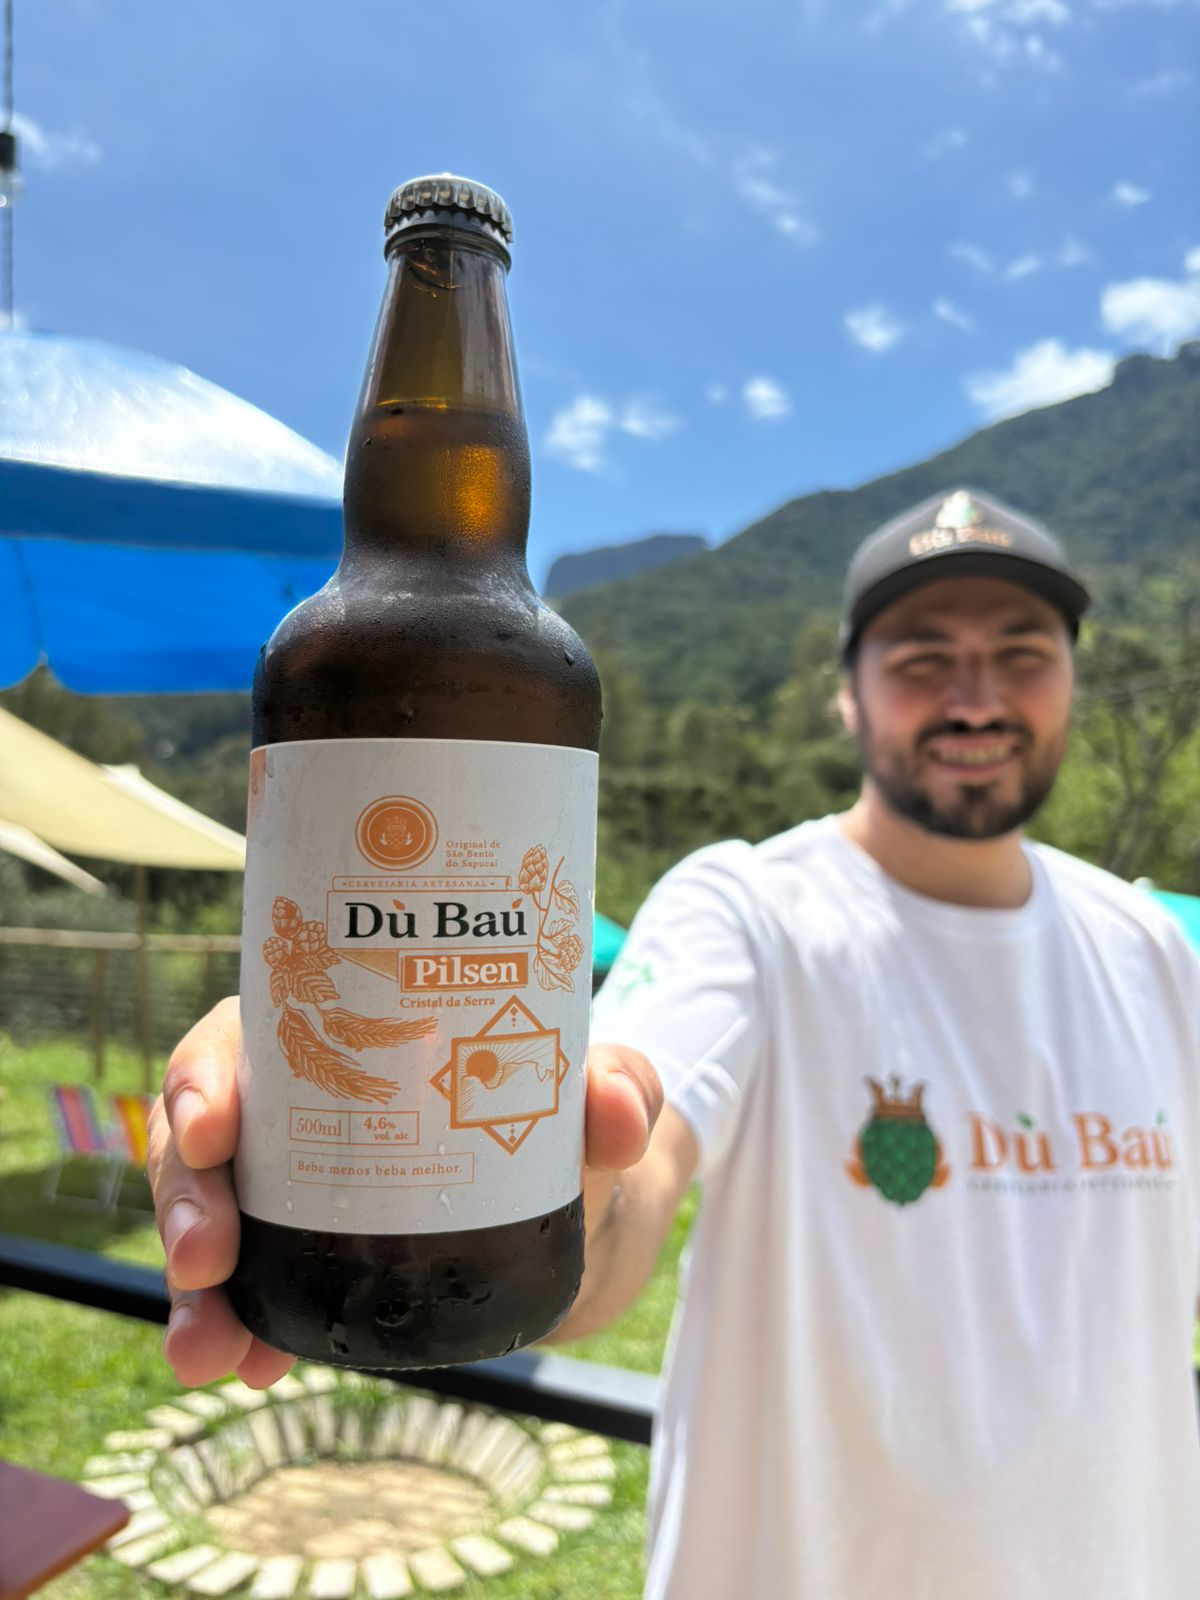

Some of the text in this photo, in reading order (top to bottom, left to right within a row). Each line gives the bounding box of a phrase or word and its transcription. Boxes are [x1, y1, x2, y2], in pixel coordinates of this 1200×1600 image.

[446, 839, 501, 849] Original de
[446, 849, 494, 859] São Bento
[446, 860, 459, 868] do
[423, 880, 488, 888] ARTESANAL
[413, 956, 519, 986] Pilsen
[400, 996, 496, 1008] Cristal da Serra
[295, 1117, 342, 1137] 500ml
[363, 1117, 397, 1132] 4,6%
[394, 1131, 409, 1140] alc
[297, 1160, 463, 1176] Beba menos beba melhor.
